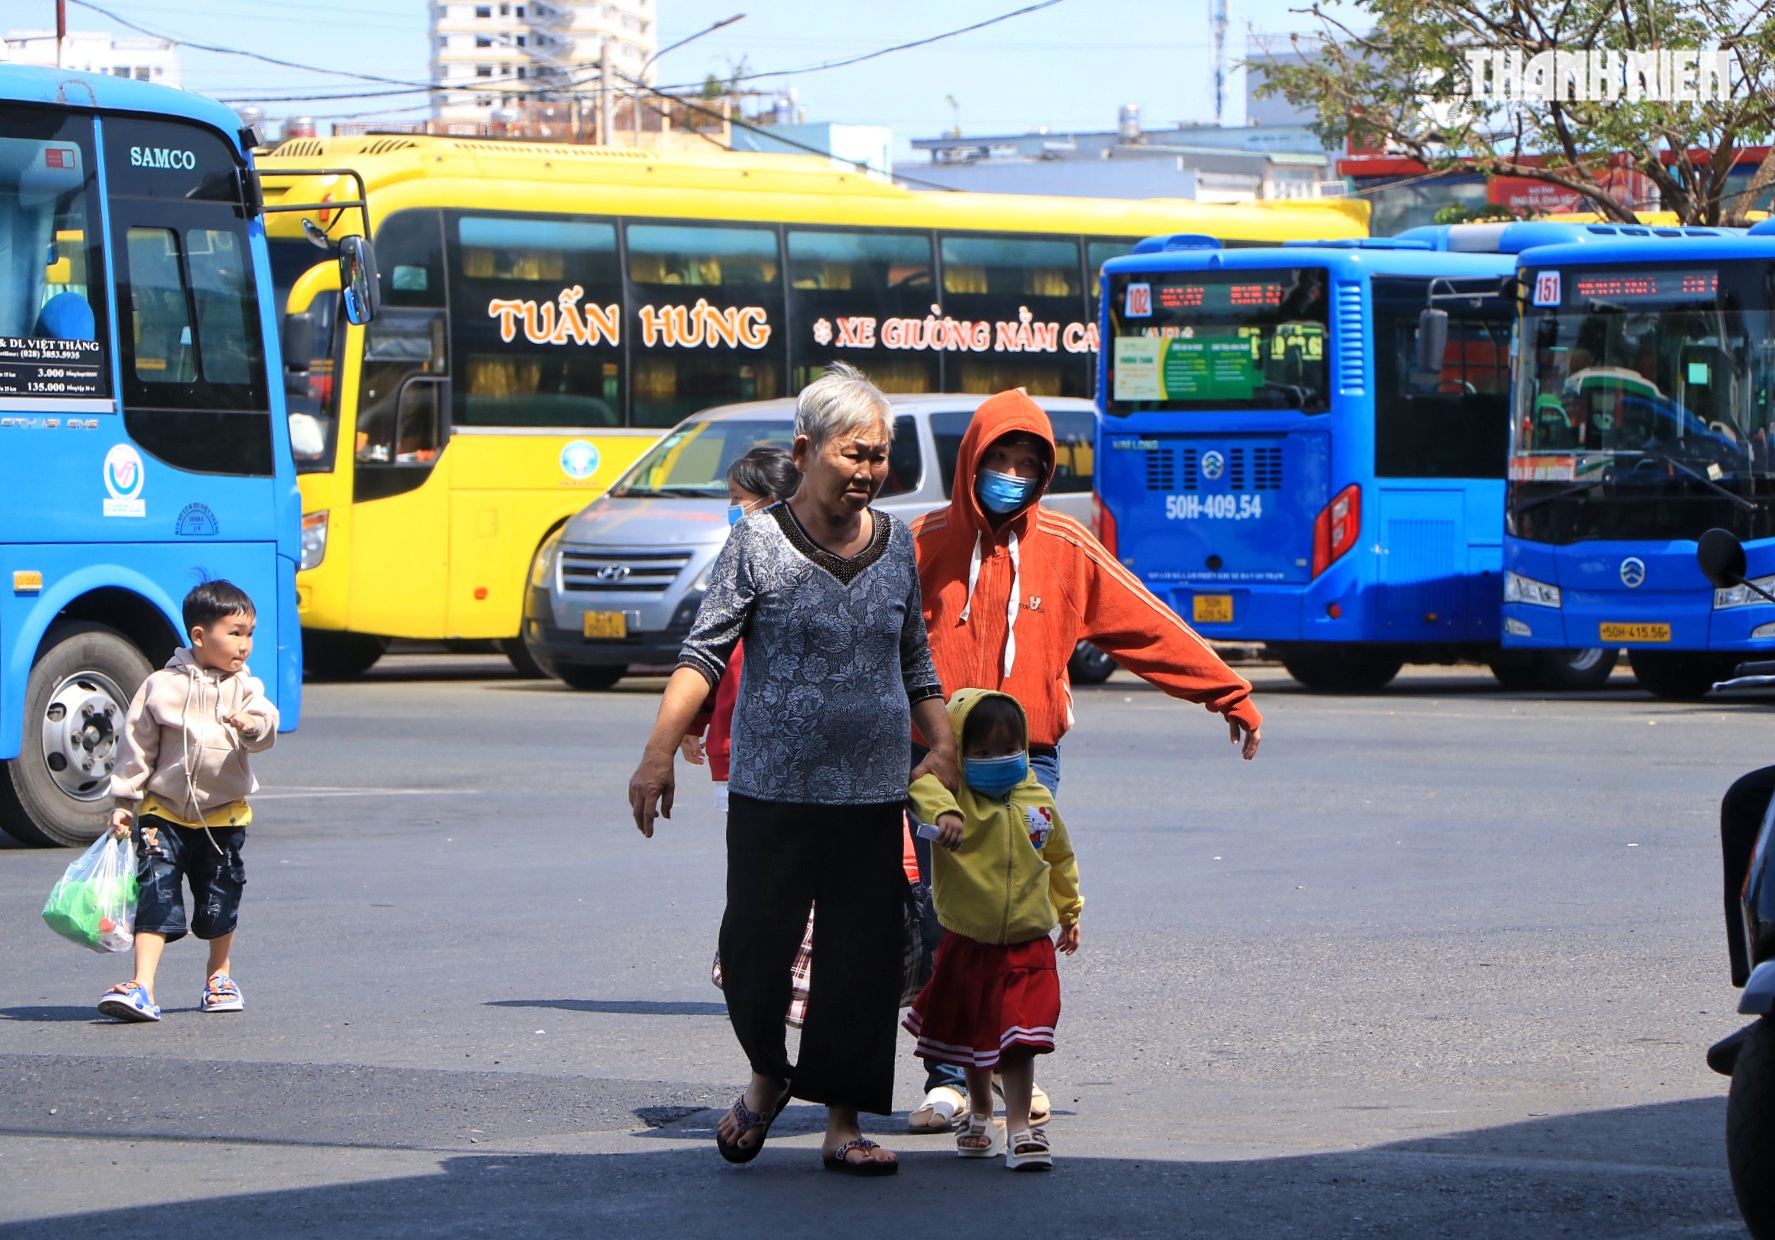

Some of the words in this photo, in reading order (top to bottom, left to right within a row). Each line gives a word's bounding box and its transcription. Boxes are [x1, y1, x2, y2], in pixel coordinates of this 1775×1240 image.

[130, 146, 196, 170] SAMCO
[1129, 288, 1149, 315] 102
[1536, 277, 1559, 302] 151
[489, 285, 620, 346] TUẤN
[639, 298, 771, 349] HƯNG
[835, 317, 876, 348] XE
[881, 303, 991, 351] GIƯỜNG
[994, 305, 1060, 353] NẰM
[0, 339, 7, 348] &
[10, 339, 26, 348] DL
[28, 338, 56, 351] VIỆT
[20, 350, 40, 359] (028)
[42, 350, 80, 360] 3853.5935
[38, 368, 64, 378] 3.000
[27, 382, 65, 392] 135.000
[1, 417, 36, 428] CITY
[66, 418, 98, 429] CNG
[1166, 494, 1262, 520] 50H-409.54
